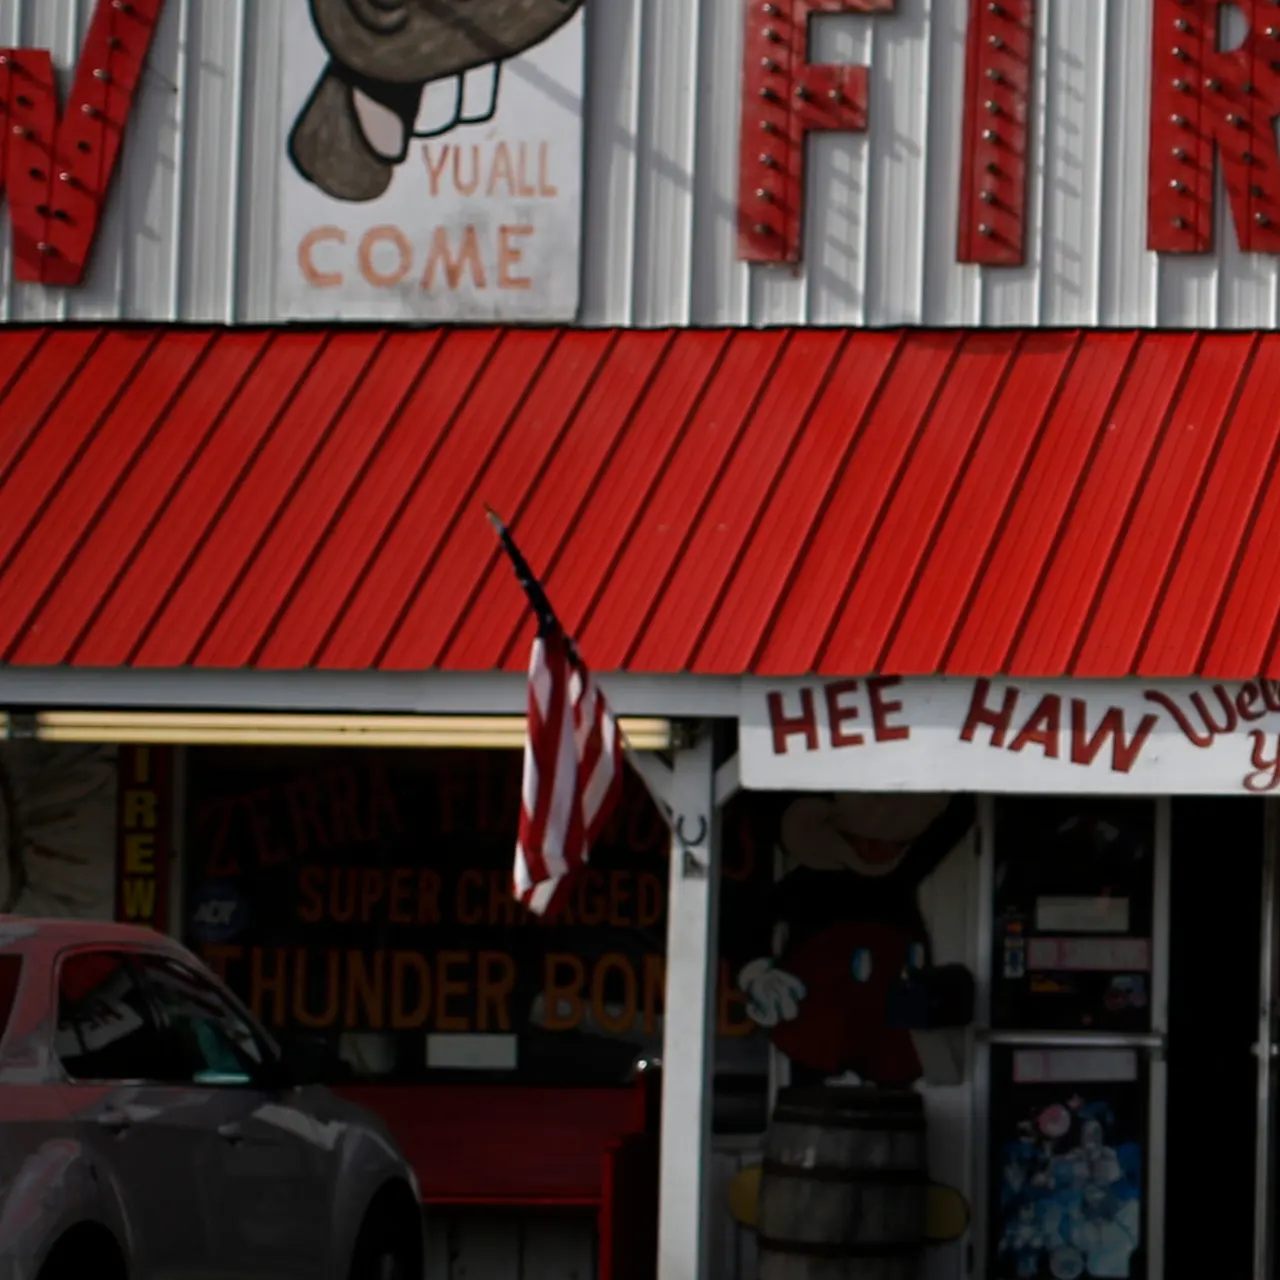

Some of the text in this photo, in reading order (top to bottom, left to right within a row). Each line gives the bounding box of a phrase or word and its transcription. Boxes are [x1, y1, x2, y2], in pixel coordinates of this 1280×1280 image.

[298, 223, 536, 291] COME
[767, 676, 910, 754] HEE
[959, 677, 1158, 774] HAW
[297, 865, 442, 926] SUPER
[454, 866, 662, 927] CHGED
